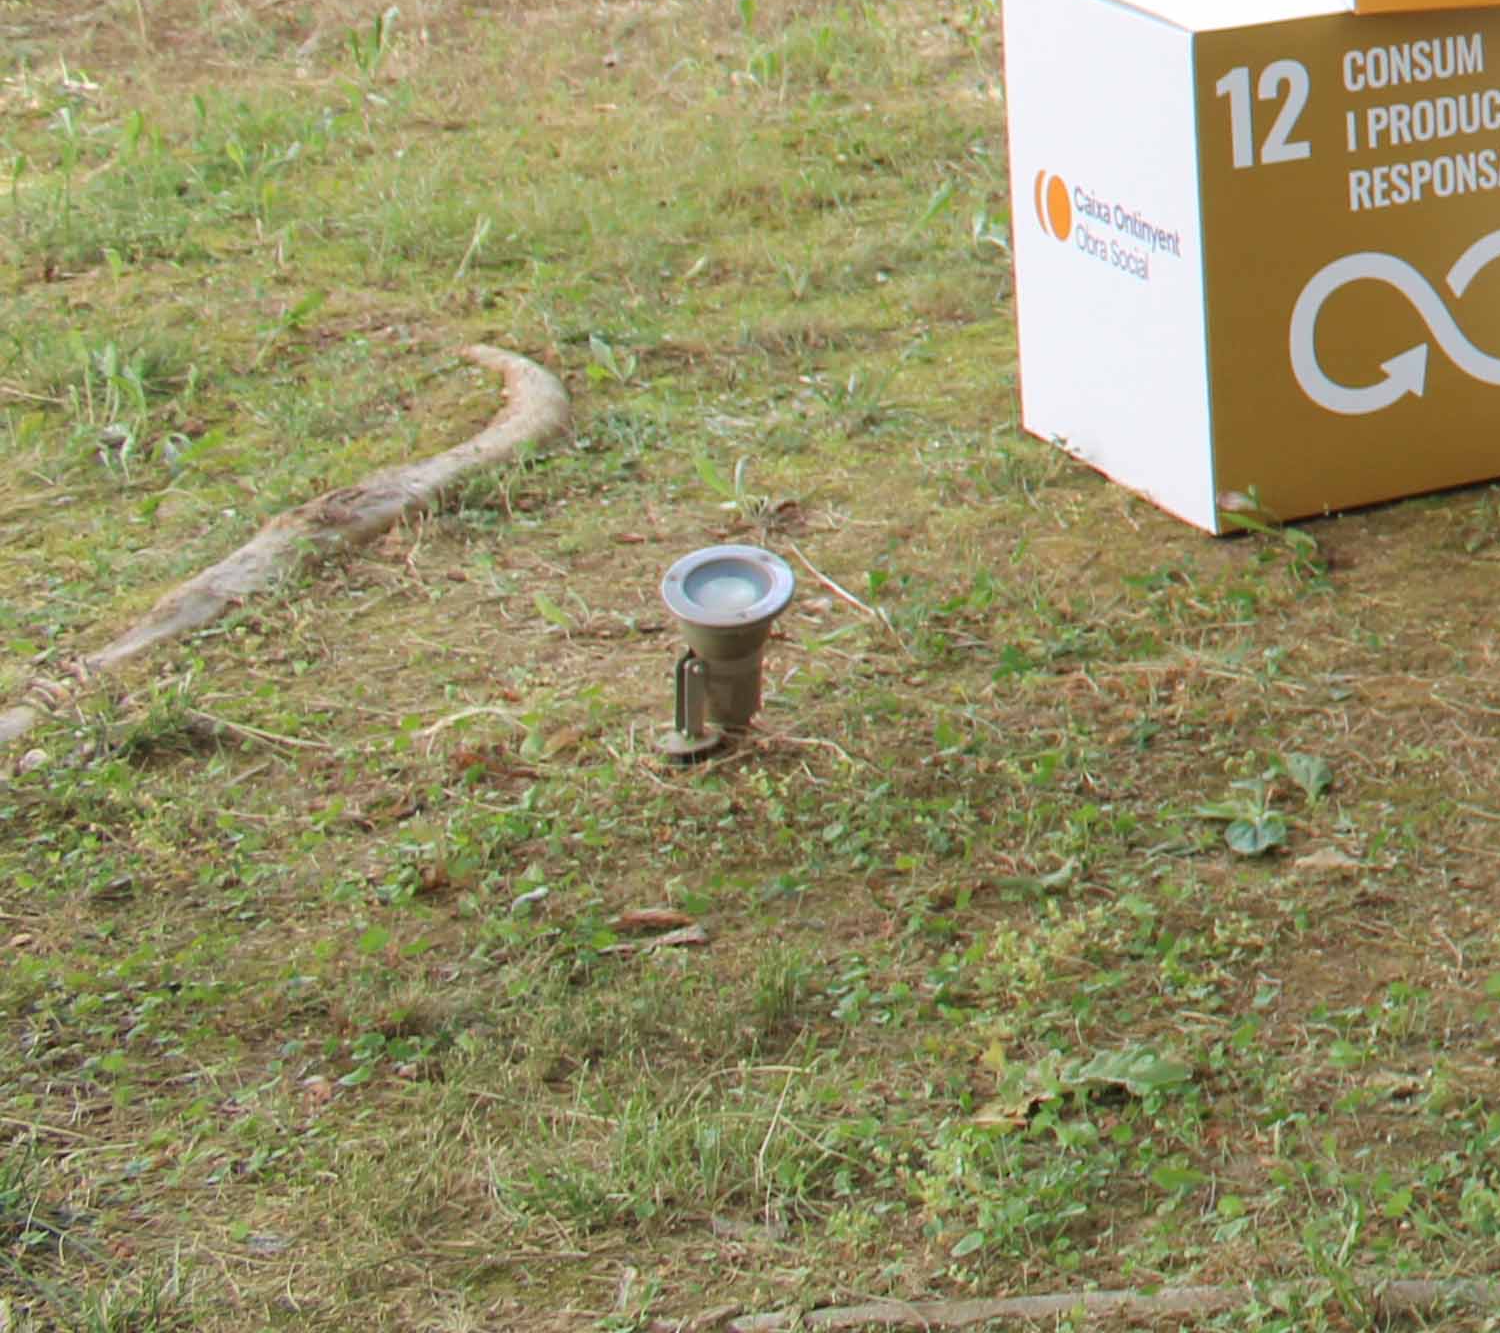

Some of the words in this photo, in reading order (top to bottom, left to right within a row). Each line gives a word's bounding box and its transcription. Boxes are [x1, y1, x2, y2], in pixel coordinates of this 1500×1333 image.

[1343, 33, 1484, 92] CONSUM
[1215, 59, 1312, 169] 12
[1346, 110, 1357, 152] I
[1074, 185, 1111, 224] Caixa
[1114, 203, 1181, 258] Ontinyent
[1075, 222, 1107, 262] Obra
[1110, 239, 1149, 280] Social
